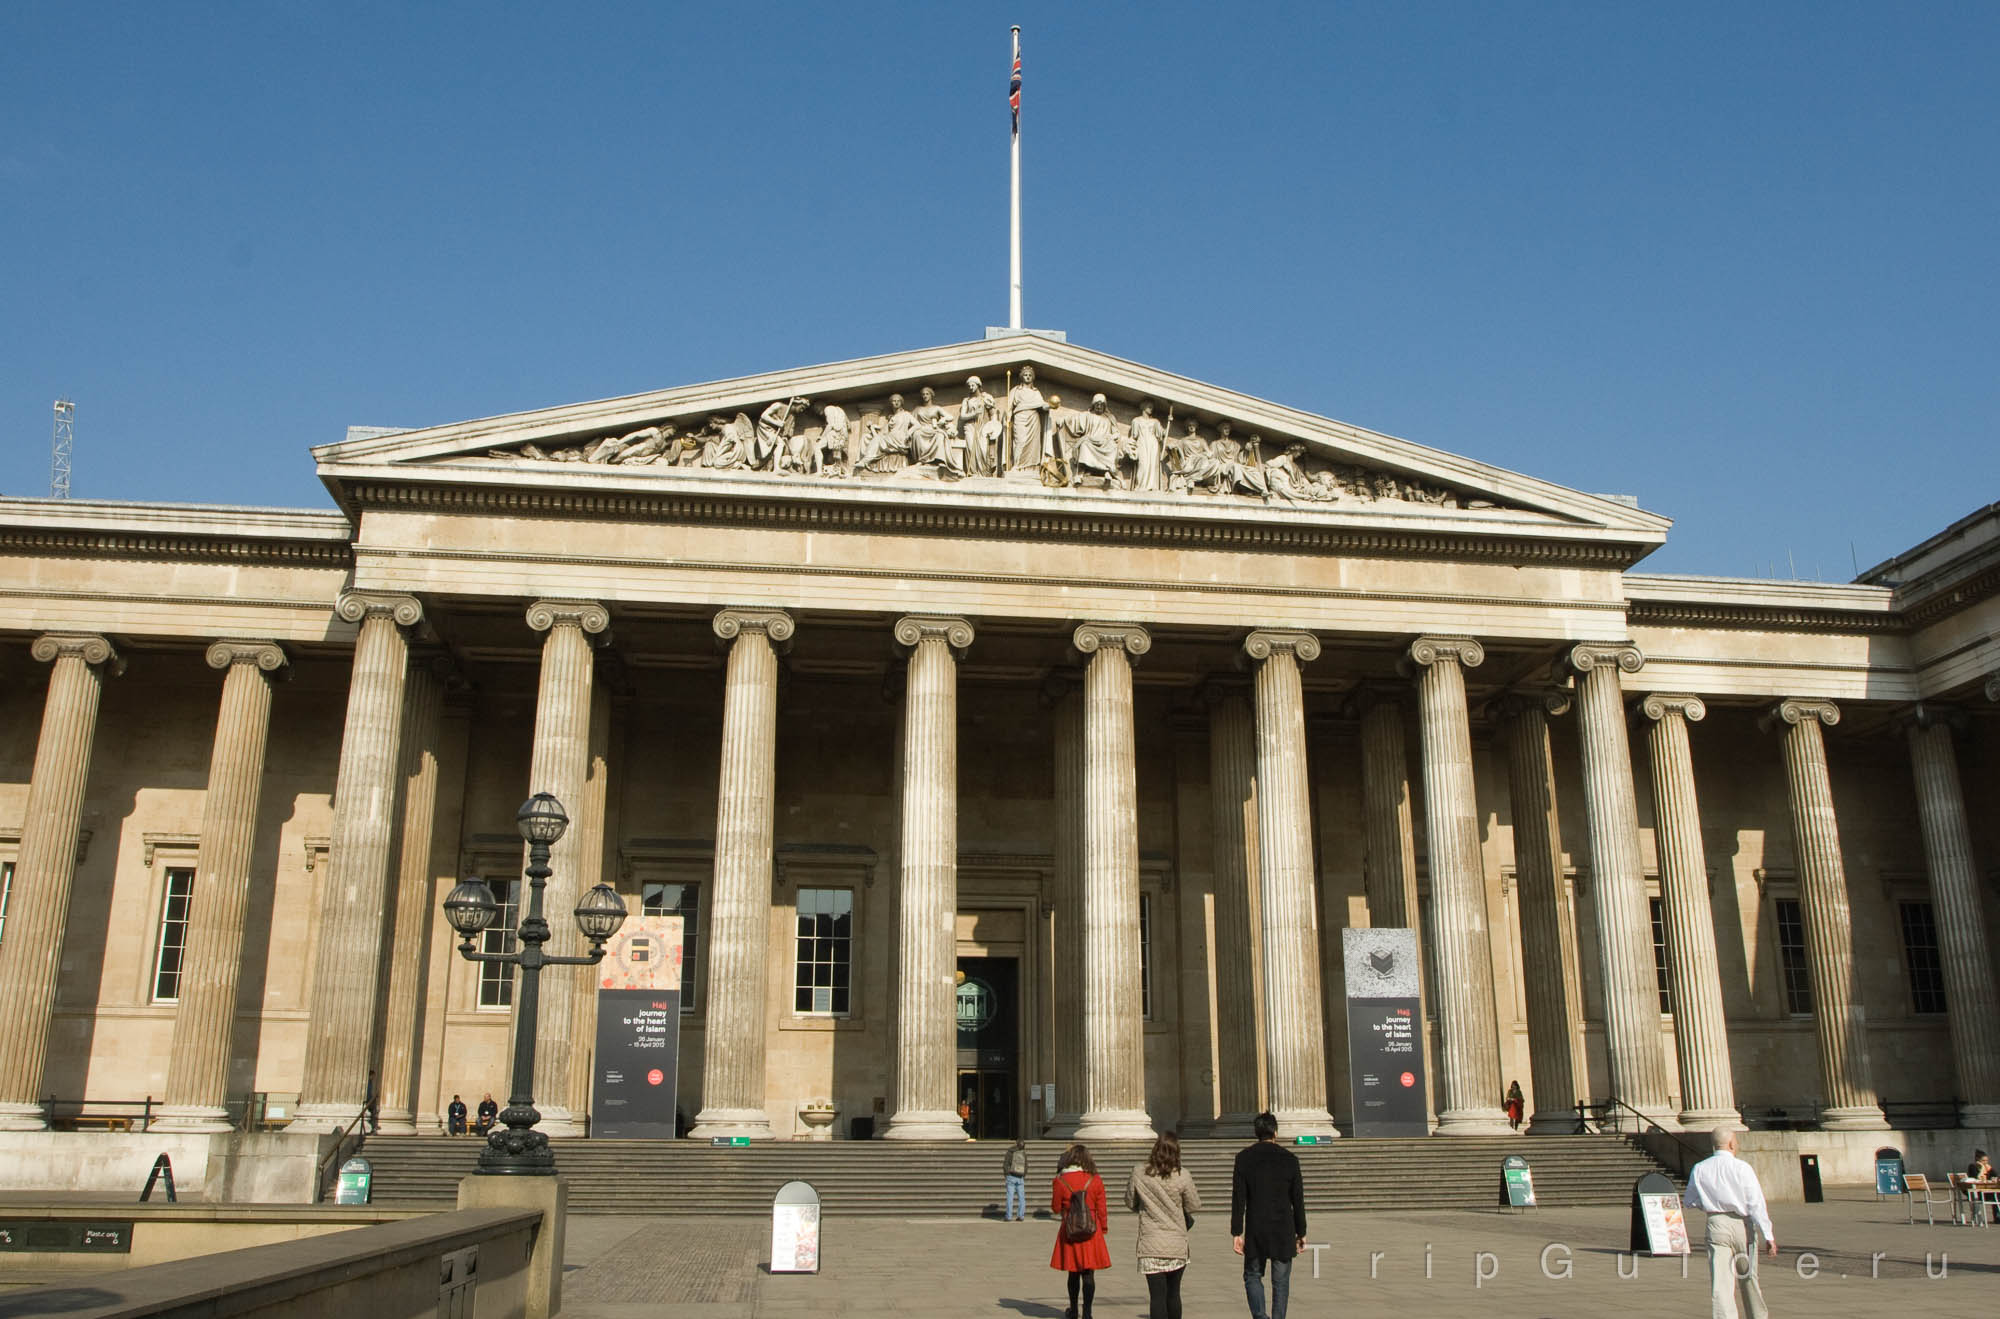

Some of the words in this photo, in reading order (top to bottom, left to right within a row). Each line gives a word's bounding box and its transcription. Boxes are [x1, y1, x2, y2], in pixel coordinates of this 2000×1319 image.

[652, 1001, 667, 1010] Hajj
[639, 1009, 667, 1018] journey
[623, 1017, 631, 1025] to
[633, 1017, 645, 1025] the
[646, 1017, 666, 1025] heart
[1386, 1016, 1411, 1024] journey
[636, 1025, 644, 1033] of
[645, 1025, 666, 1033] Islam
[0, 1229, 9, 1238] nly
[106, 1231, 119, 1239] only
